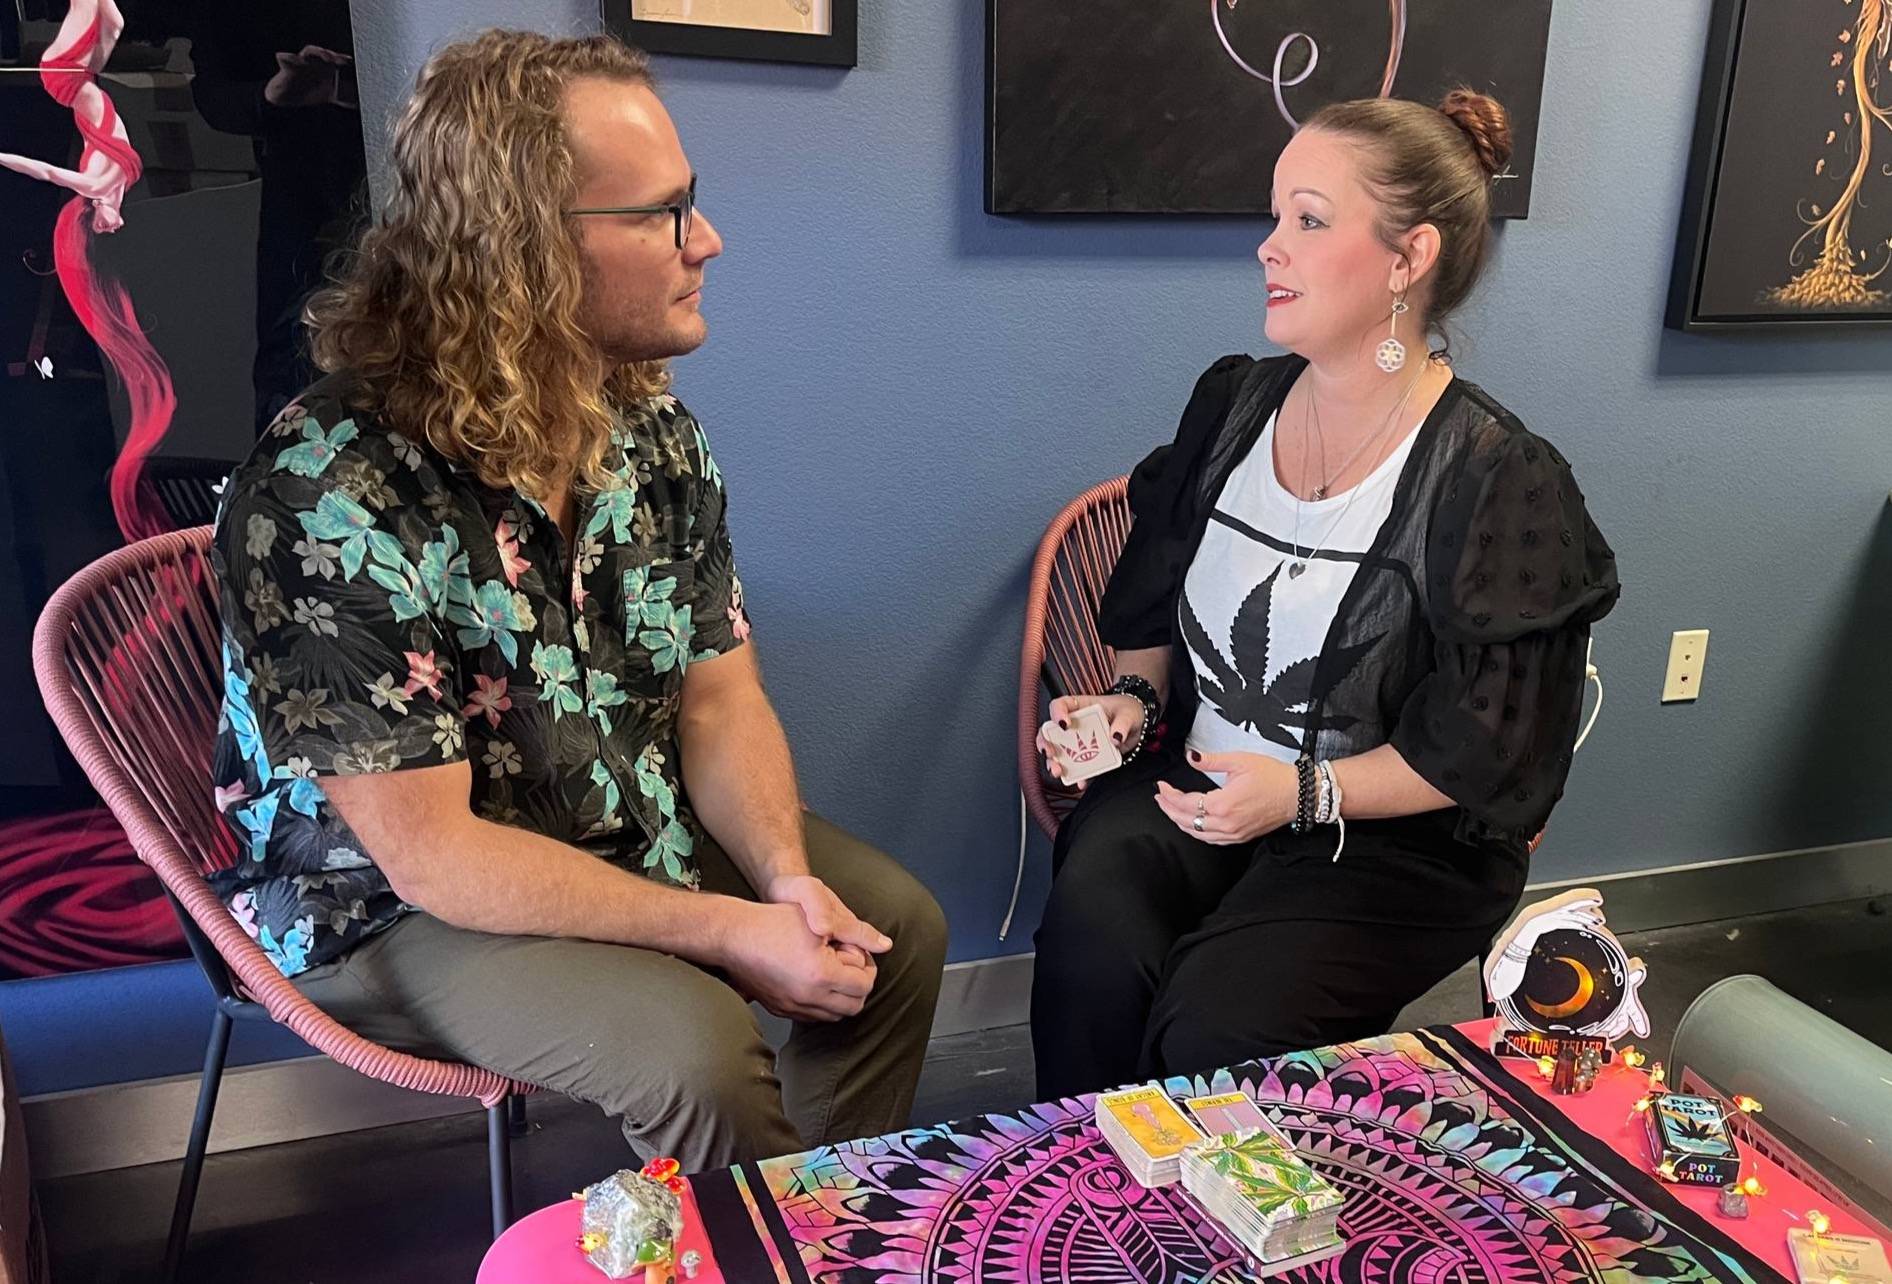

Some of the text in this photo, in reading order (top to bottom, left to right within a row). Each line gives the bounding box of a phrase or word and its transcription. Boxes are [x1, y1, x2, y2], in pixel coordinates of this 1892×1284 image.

[1505, 1034, 1559, 1056] FORTUNE
[1671, 1098, 1704, 1108] POT
[1662, 1104, 1716, 1117] TAROT
[1688, 1162, 1716, 1173] POT
[1679, 1171, 1724, 1183] TAROT
